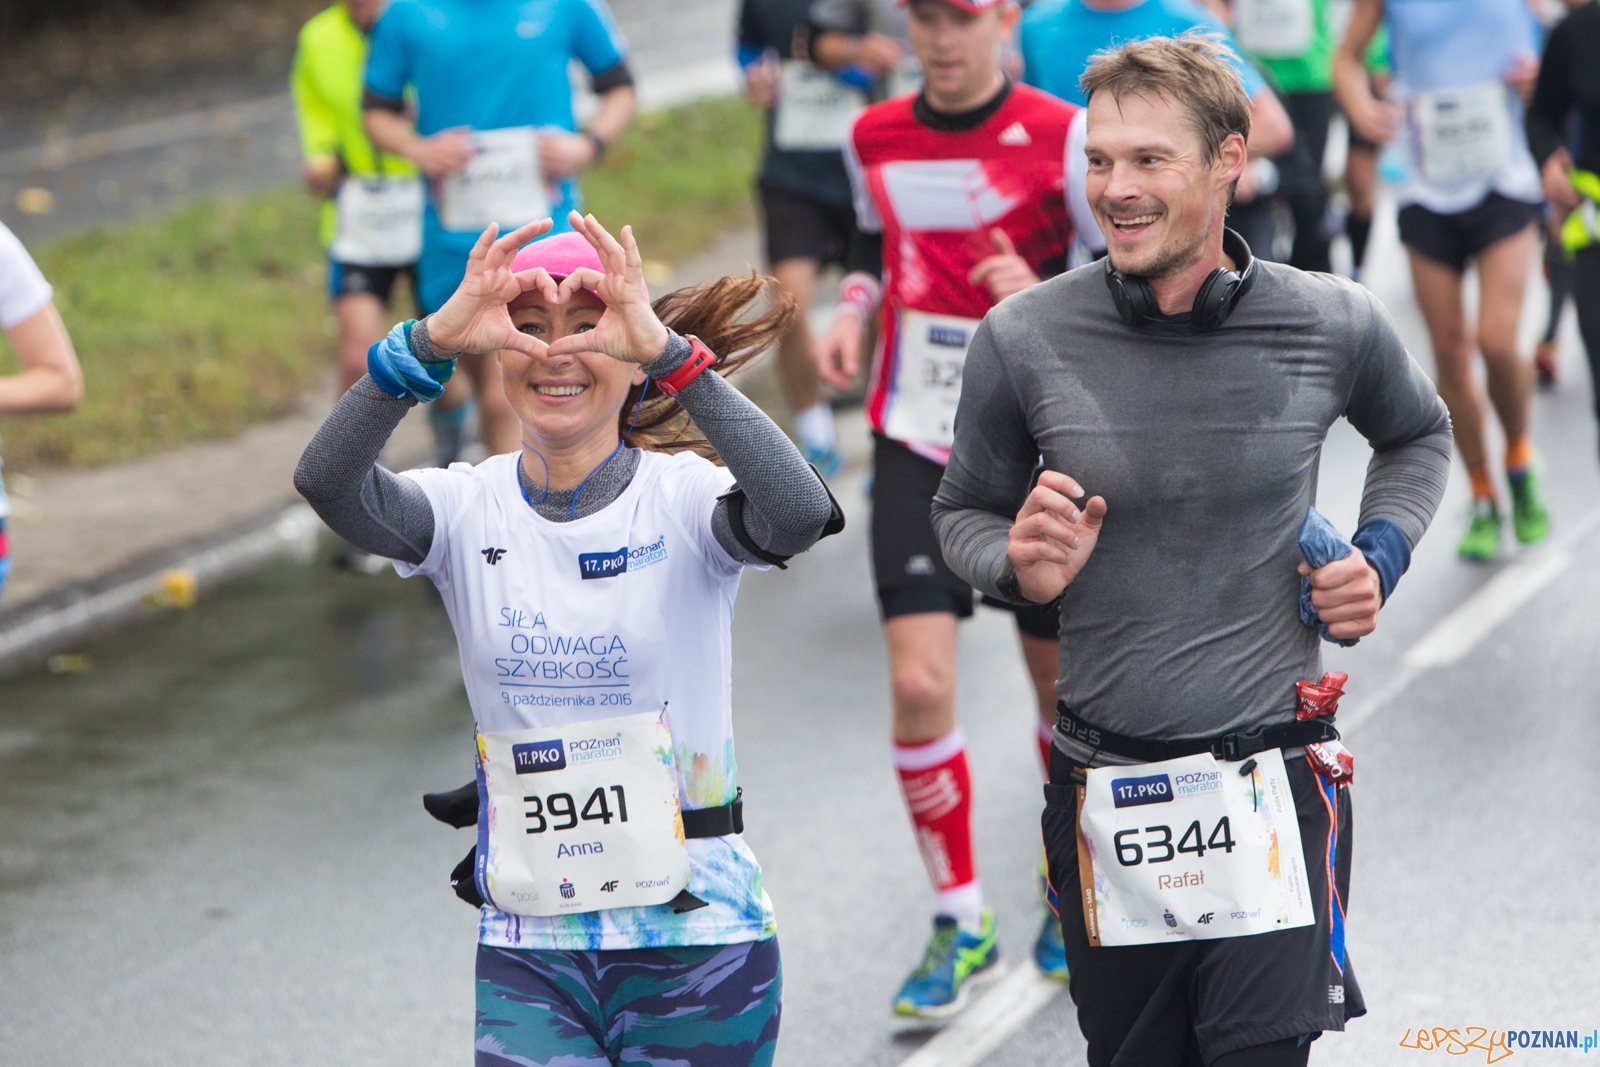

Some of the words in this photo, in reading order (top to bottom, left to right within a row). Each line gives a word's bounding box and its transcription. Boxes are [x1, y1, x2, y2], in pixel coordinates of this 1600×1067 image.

[499, 607, 547, 629] SIŁA
[511, 634, 627, 655] ODWAGA
[495, 656, 629, 679] SZYBKOŚĆ
[501, 691, 510, 704] 9
[513, 693, 595, 707] października
[600, 693, 632, 706] 2016
[571, 747, 622, 762] maraton
[1177, 780, 1222, 795] maraton
[523, 784, 628, 834] 3941
[557, 841, 604, 859] Anna
[1113, 816, 1236, 867] 6344
[600, 880, 619, 893] 4F
[1158, 870, 1205, 890] Rafał
[1197, 912, 1215, 925] 4F
